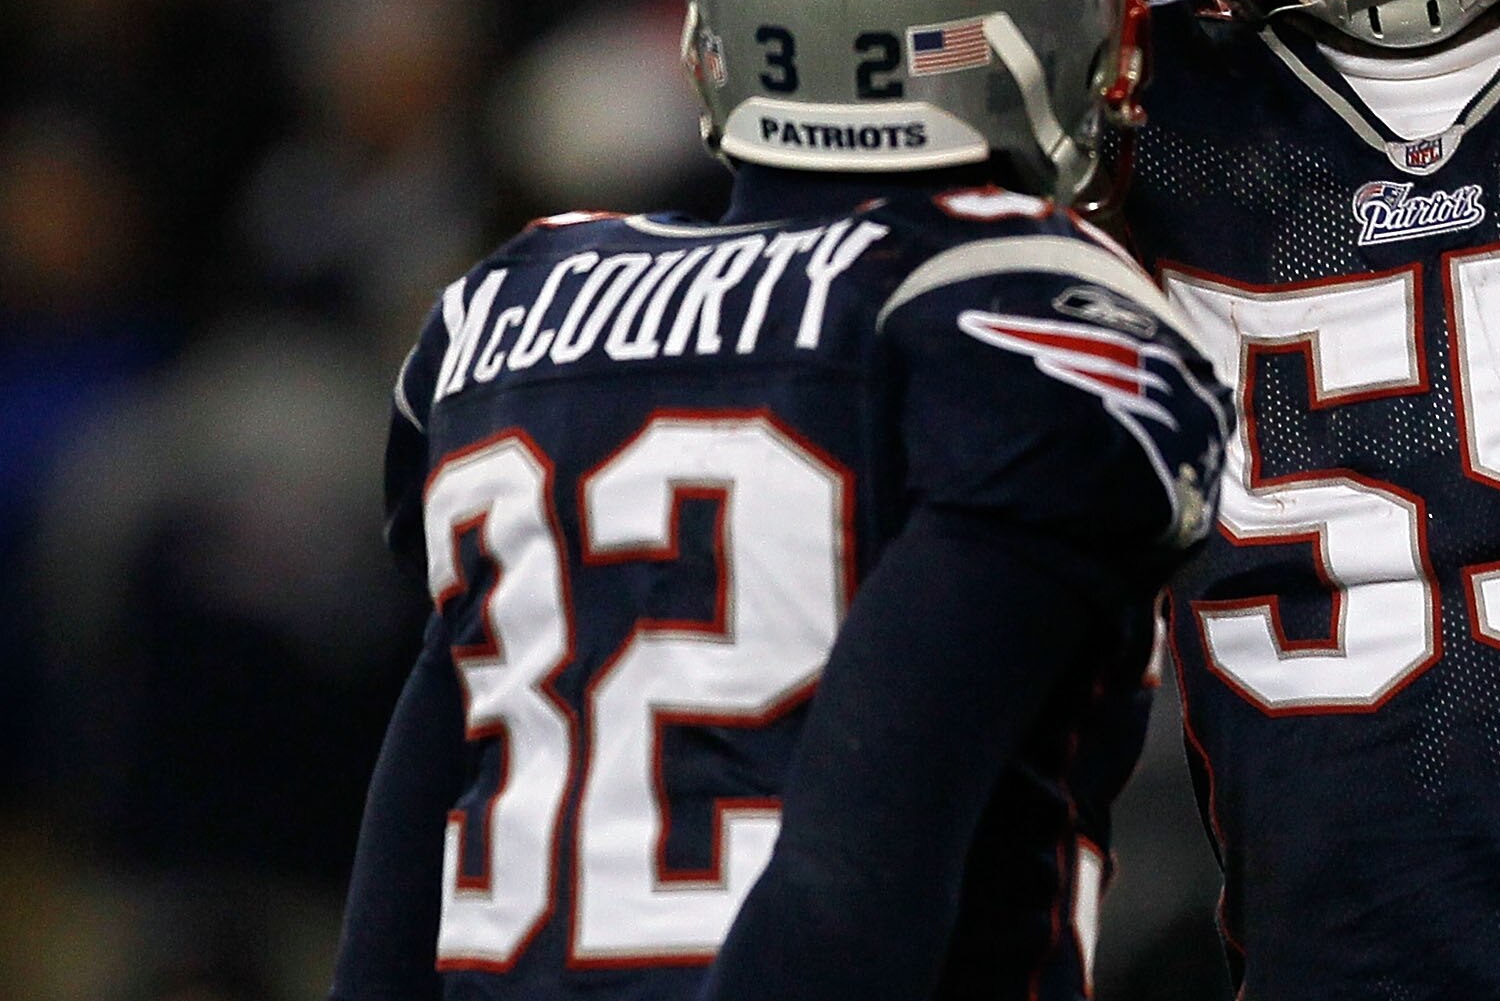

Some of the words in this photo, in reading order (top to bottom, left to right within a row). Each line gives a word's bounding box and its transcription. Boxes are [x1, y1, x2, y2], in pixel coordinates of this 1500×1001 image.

[760, 117, 926, 149] PATRIOTS
[1409, 147, 1440, 165] NFL
[1360, 186, 1479, 242] Patriots
[433, 217, 889, 402] McCOURTY
[423, 408, 856, 972] 32
